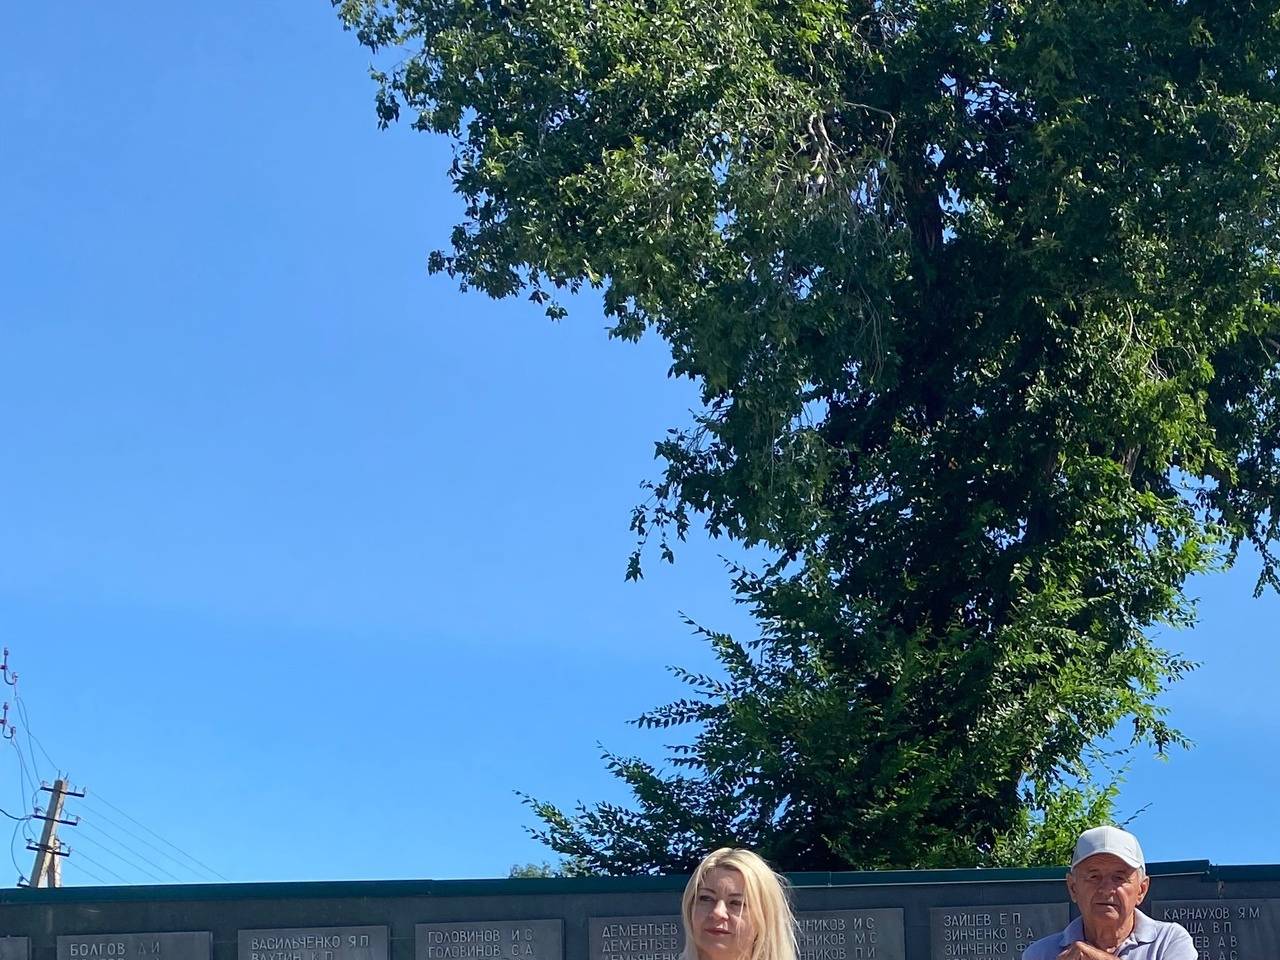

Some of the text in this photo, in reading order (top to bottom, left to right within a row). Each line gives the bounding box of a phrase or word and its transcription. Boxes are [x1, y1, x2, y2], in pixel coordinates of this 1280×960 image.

[944, 912, 991, 926] ЗАЙЦЕВ
[1164, 907, 1229, 919] КАРНАУХОВ
[428, 929, 500, 944] ГОЛОВИНОВ
[602, 923, 678, 938] ДЕМЕНТЬЕВ
[944, 928, 1007, 941] ЗИНЧЕНКО
[71, 943, 126, 956] БОЛГОВ
[251, 935, 340, 950] ВАСИЛЬЧЕНКО
[602, 938, 678, 952] ДЕМЕНТЬЕВ
[944, 942, 1008, 955] ЗИНЧЕНКО
[428, 944, 500, 958] ГОЛОВИНОВ
